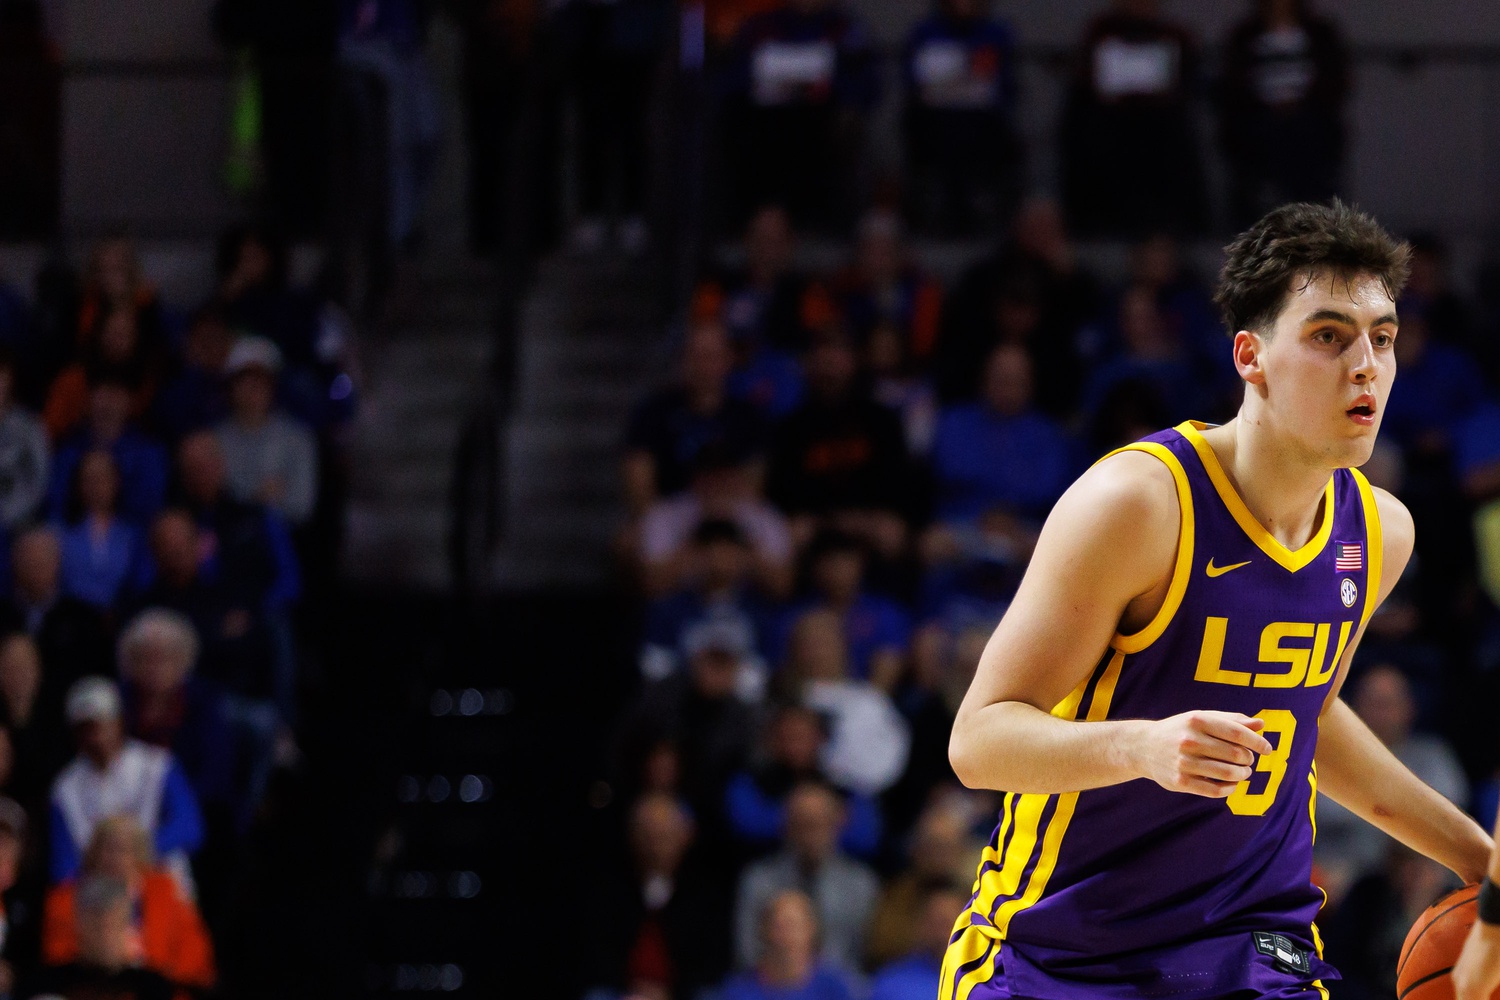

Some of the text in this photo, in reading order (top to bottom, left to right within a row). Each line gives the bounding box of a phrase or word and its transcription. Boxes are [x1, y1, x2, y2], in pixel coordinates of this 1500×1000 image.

[1341, 581, 1357, 605] SEC
[1194, 616, 1354, 689] LSU
[1226, 709, 1297, 817] 3
